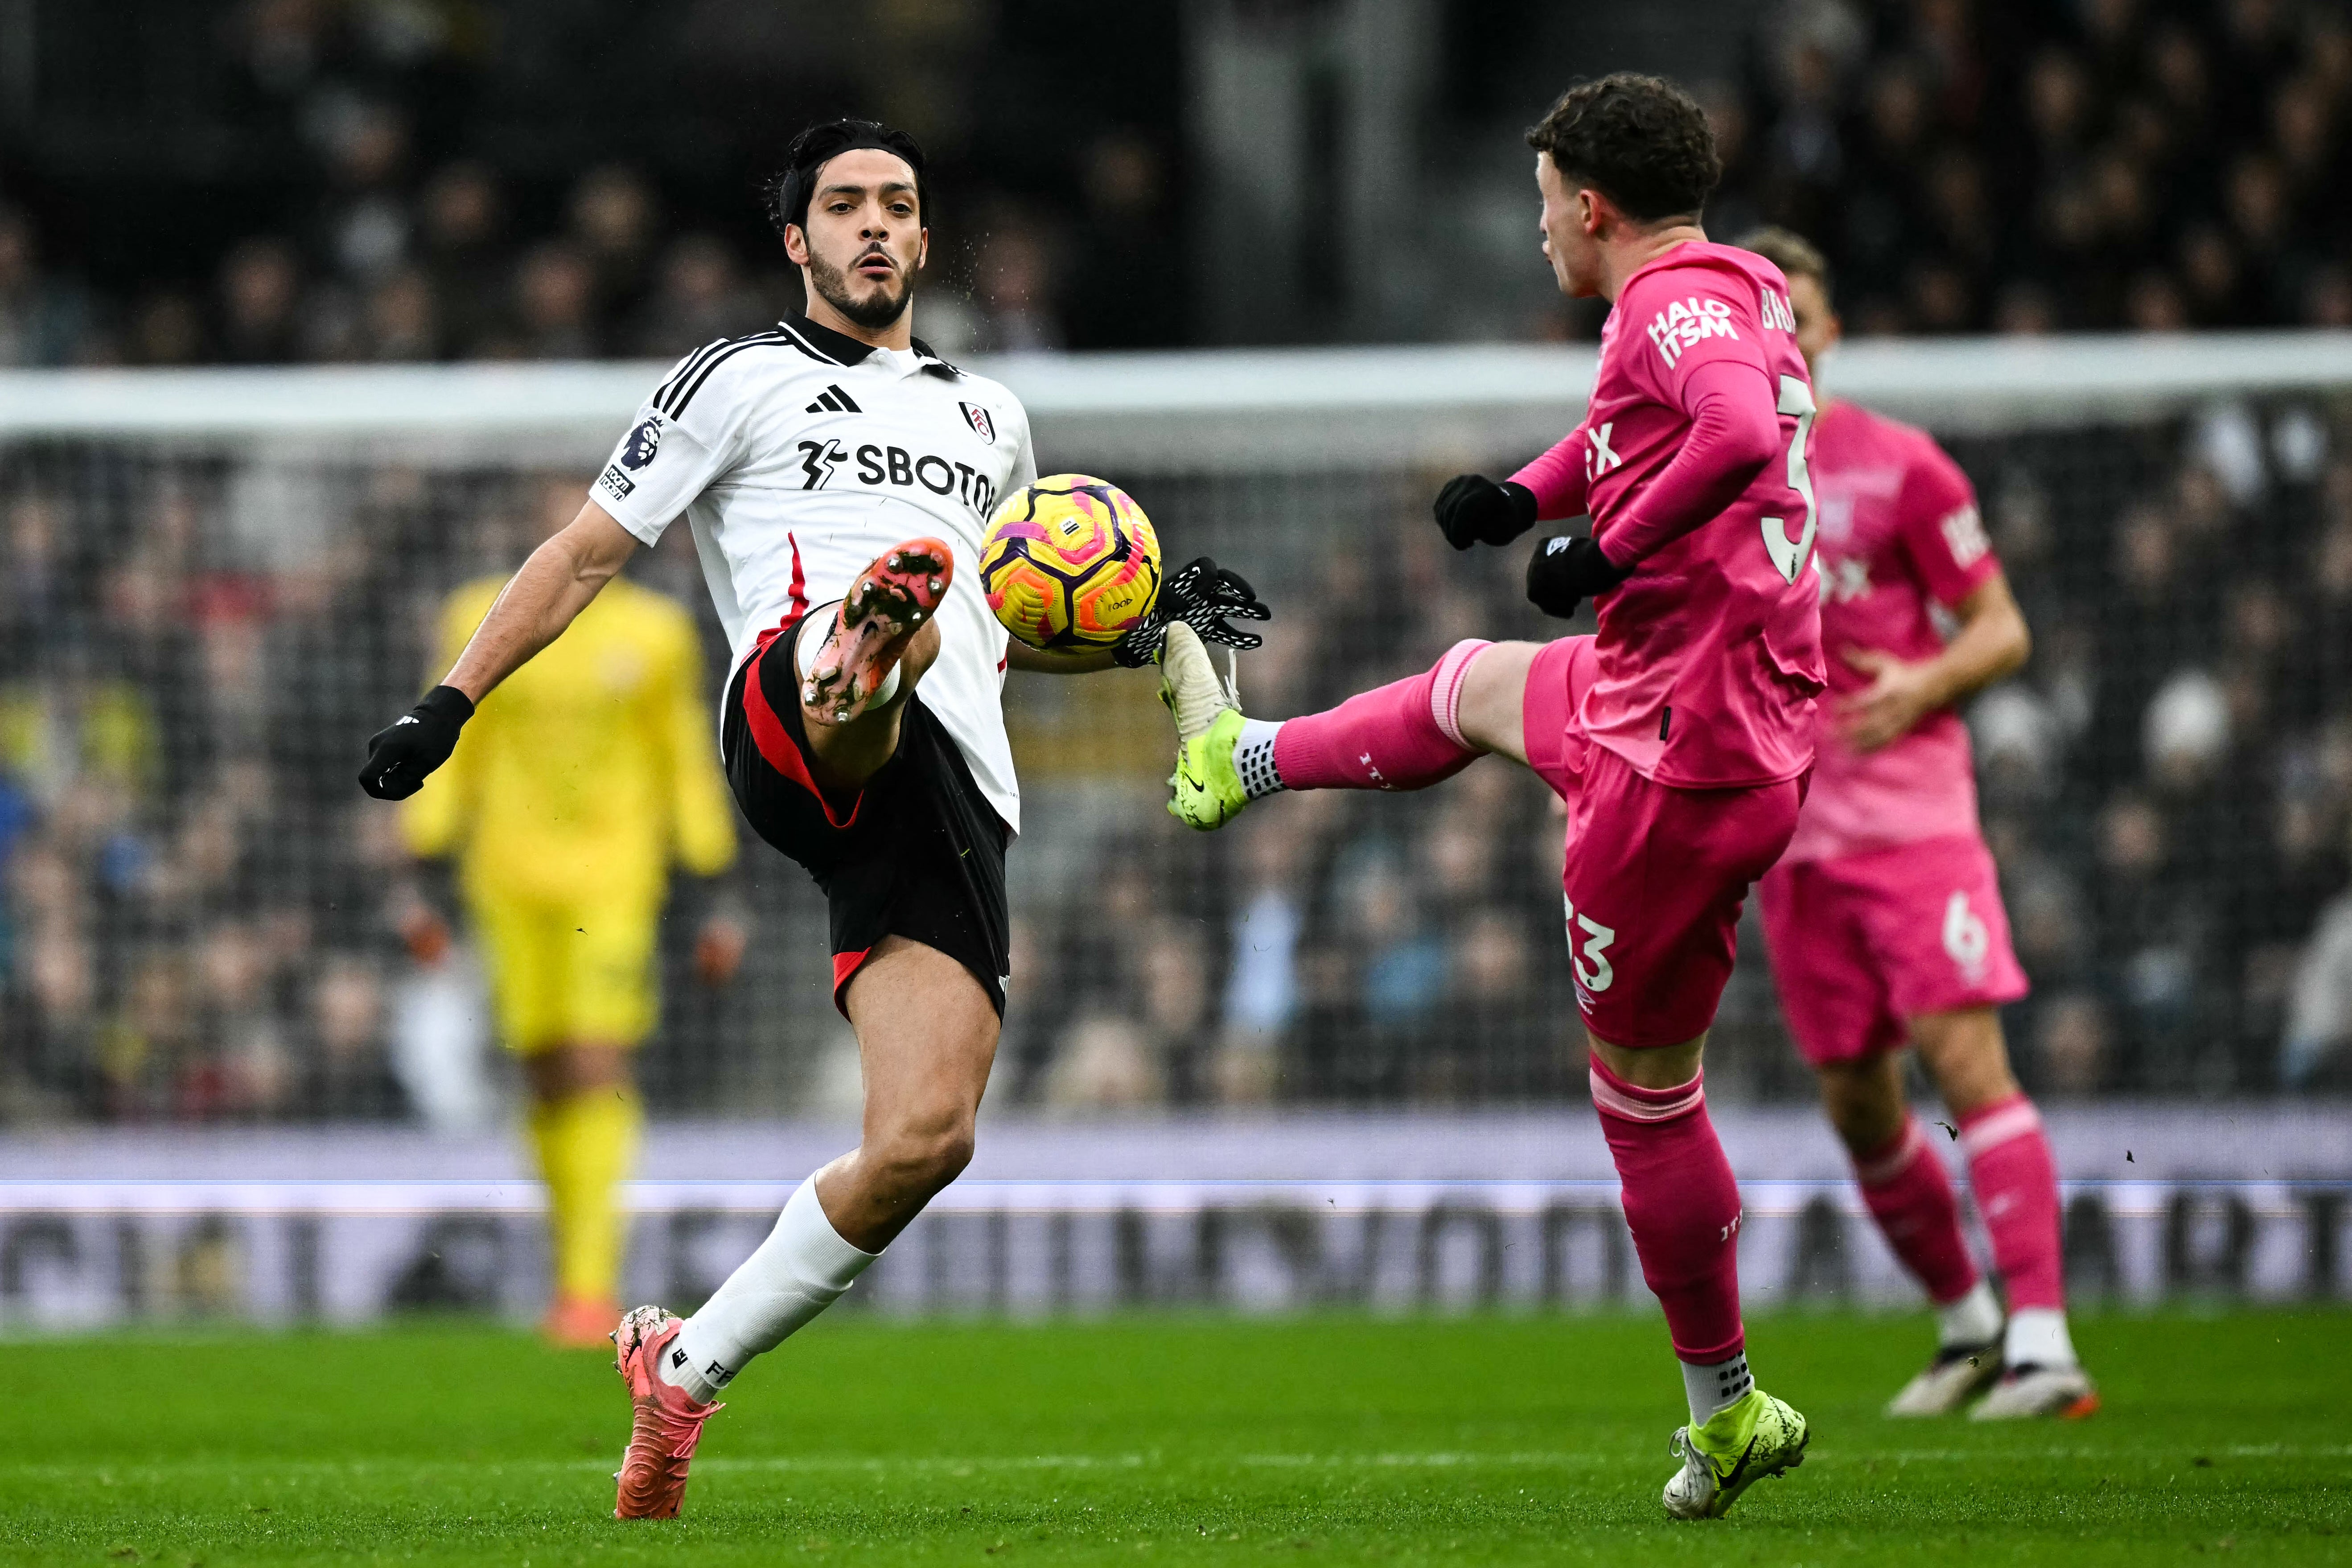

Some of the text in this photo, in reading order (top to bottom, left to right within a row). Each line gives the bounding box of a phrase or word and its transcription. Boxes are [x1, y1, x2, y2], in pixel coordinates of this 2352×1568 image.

[1648, 296, 1731, 346] HALO
[1659, 315, 1740, 370] ITSM
[606, 467, 629, 492] room
[1942, 890, 1990, 962] 6
